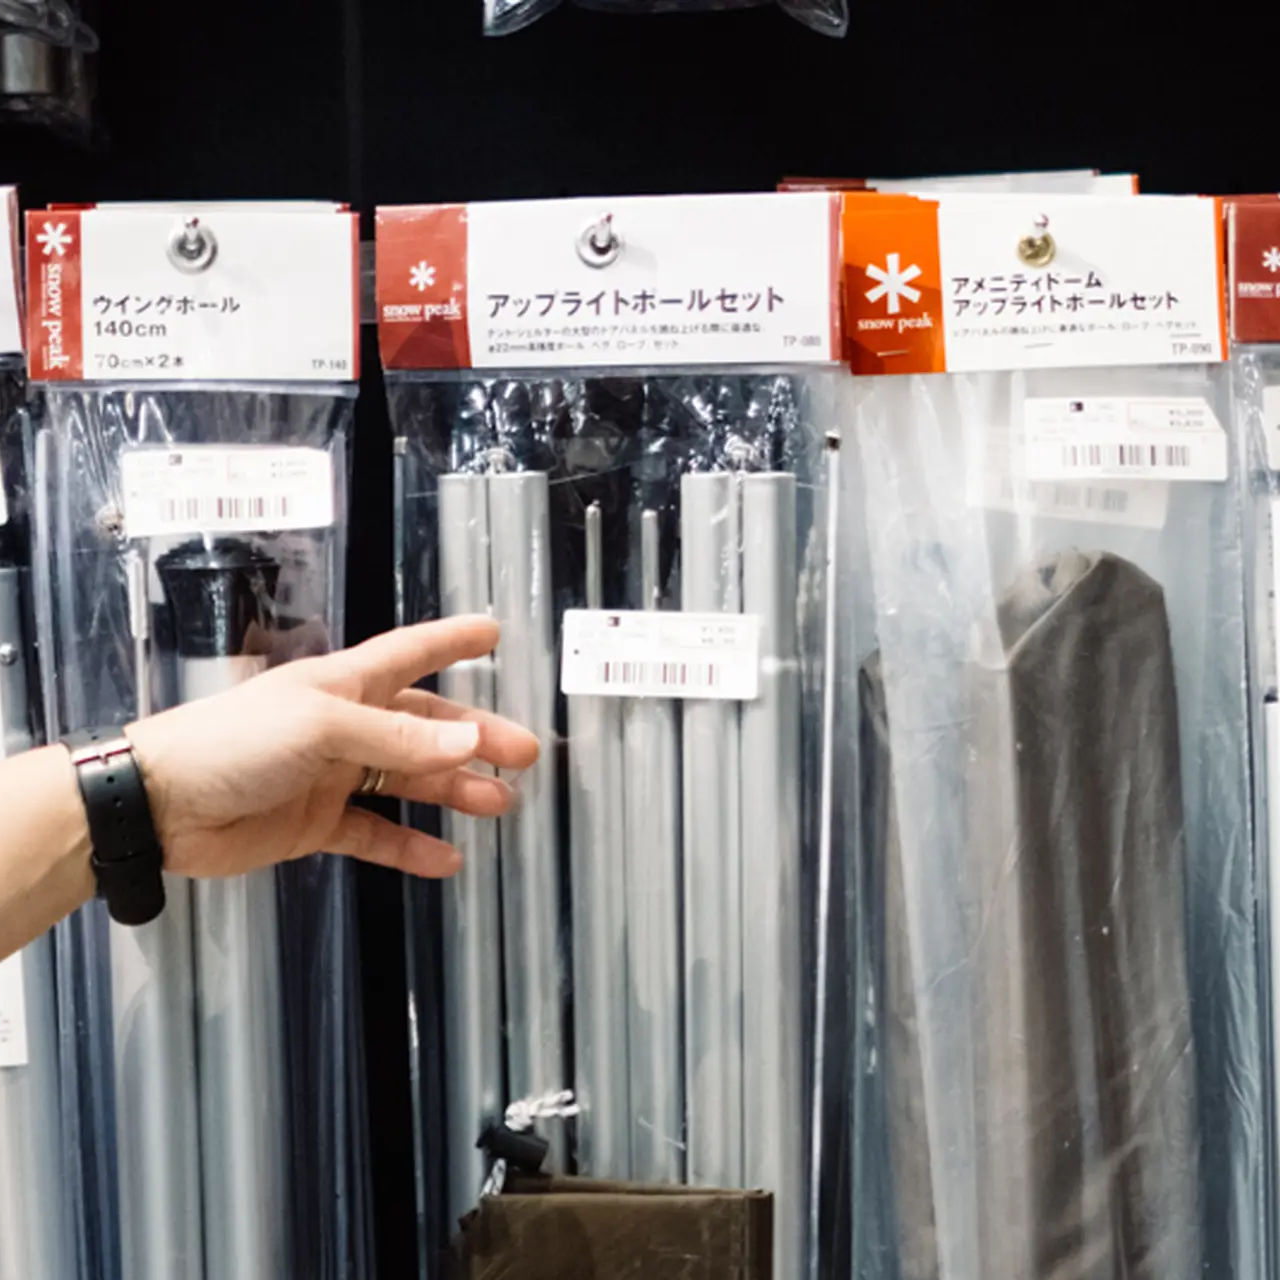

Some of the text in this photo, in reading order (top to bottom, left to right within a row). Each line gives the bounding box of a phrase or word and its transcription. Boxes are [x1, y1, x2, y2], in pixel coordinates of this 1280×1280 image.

[952, 272, 1102, 294] アメニティドーム
[1238, 280, 1273, 293] snow
[41, 263, 71, 369] snow peak
[383, 297, 462, 322] snow peak
[94, 321, 167, 337] 140cm
[858, 312, 933, 333] snow peak
